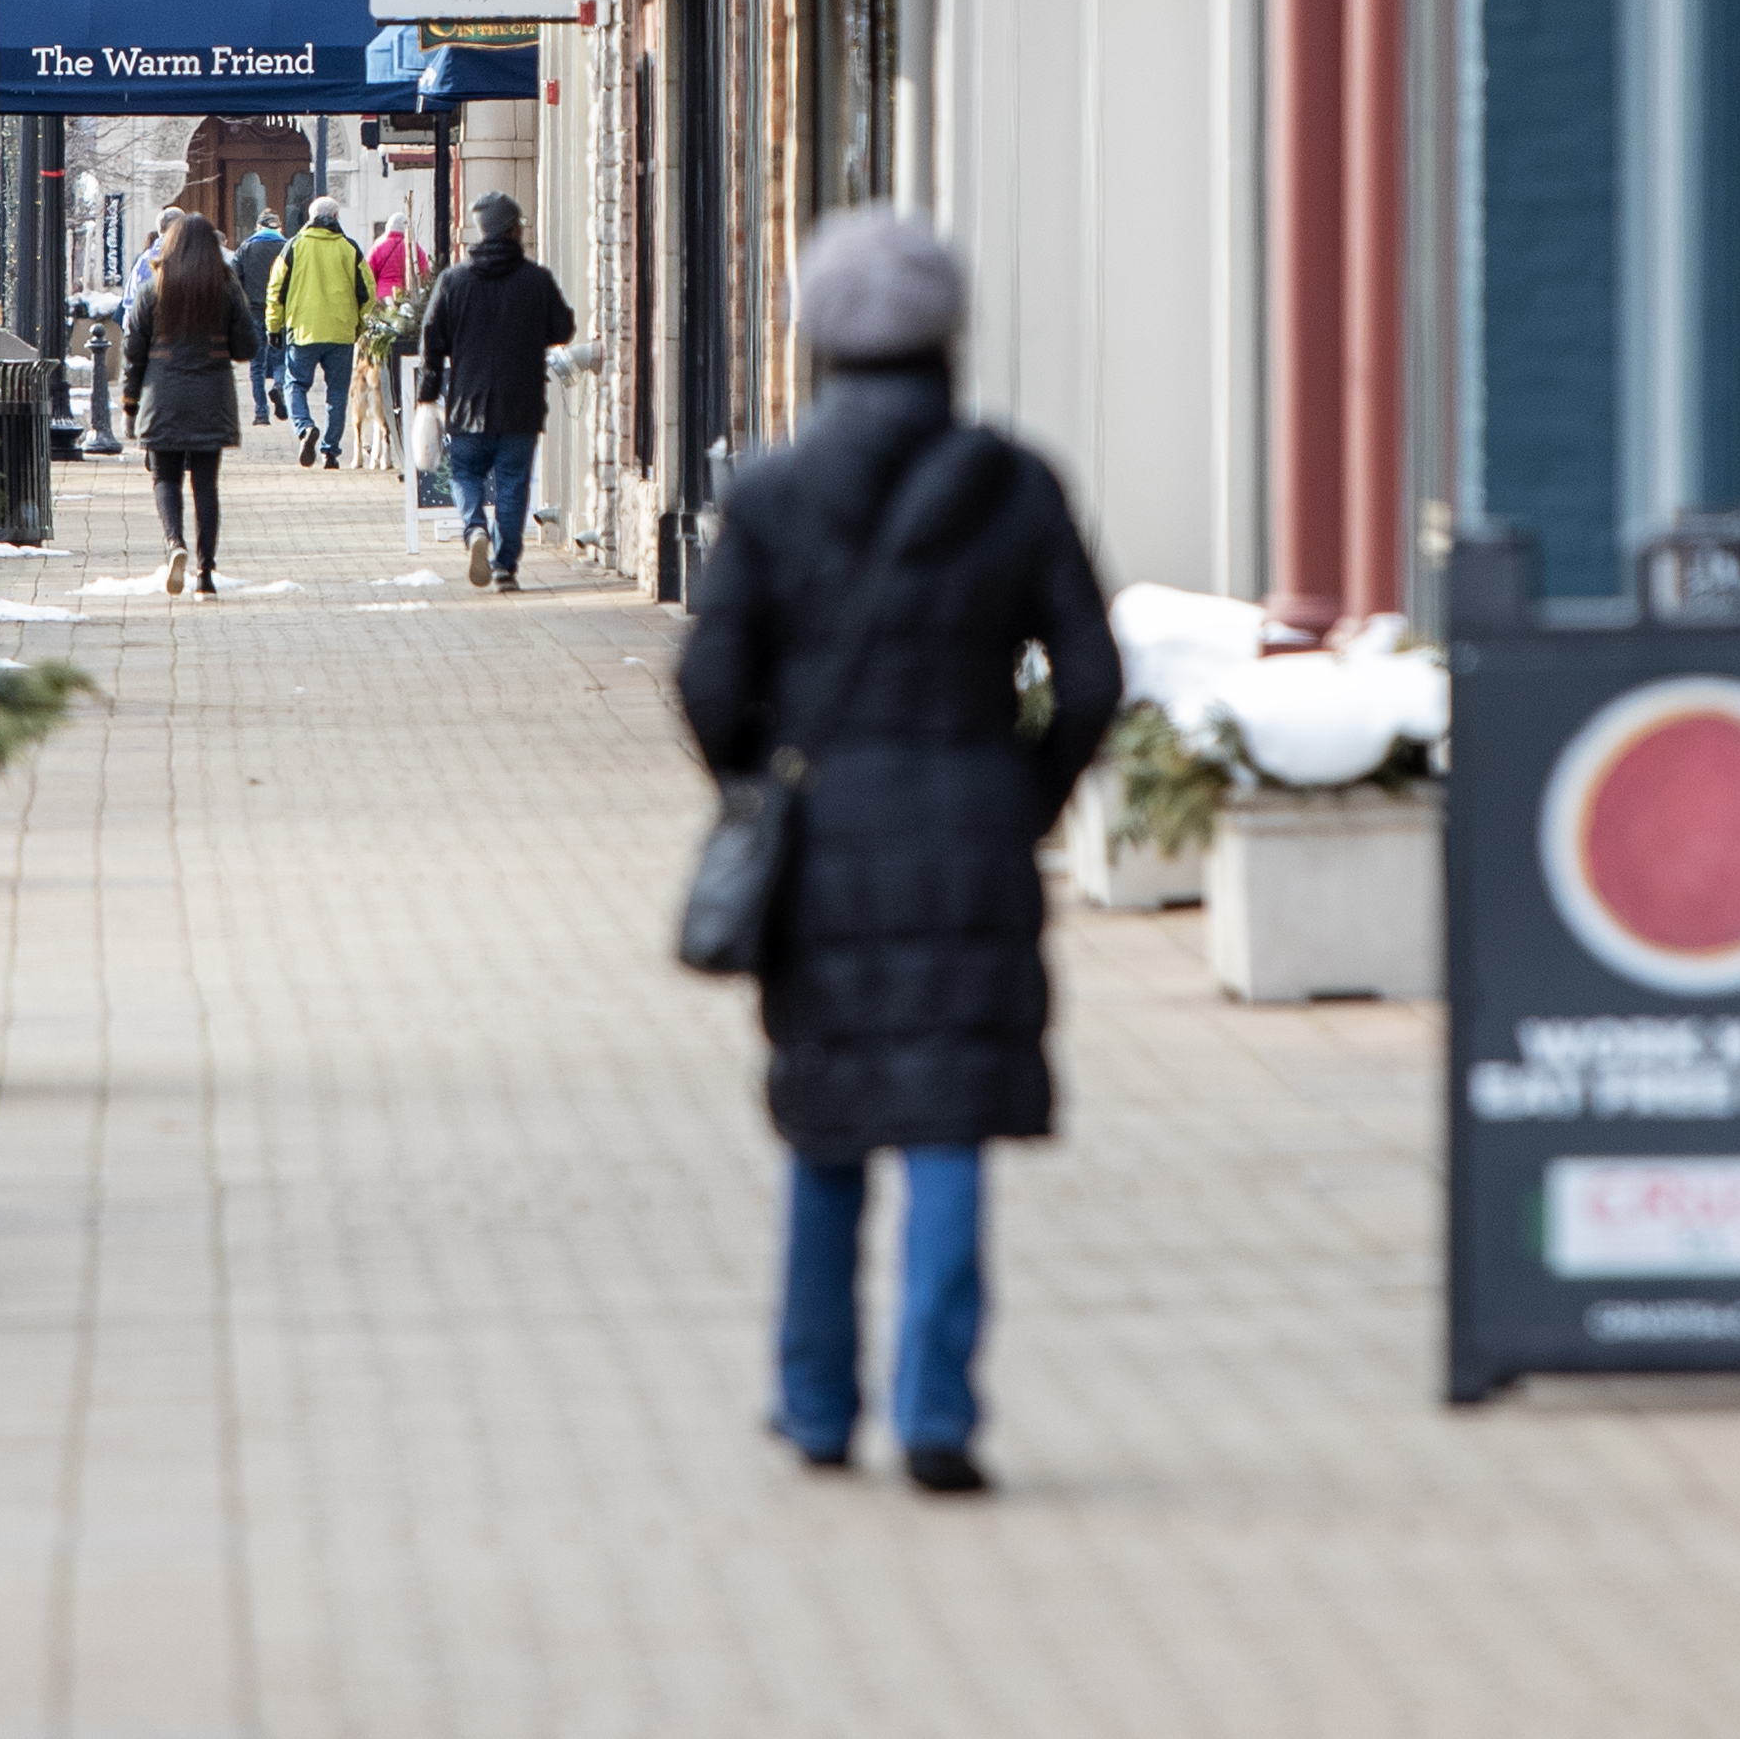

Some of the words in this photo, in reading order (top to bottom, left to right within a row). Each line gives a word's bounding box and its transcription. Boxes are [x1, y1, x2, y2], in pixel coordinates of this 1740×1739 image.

[31, 45, 94, 76] The
[101, 47, 202, 77] Warm
[210, 42, 315, 75] Friend
